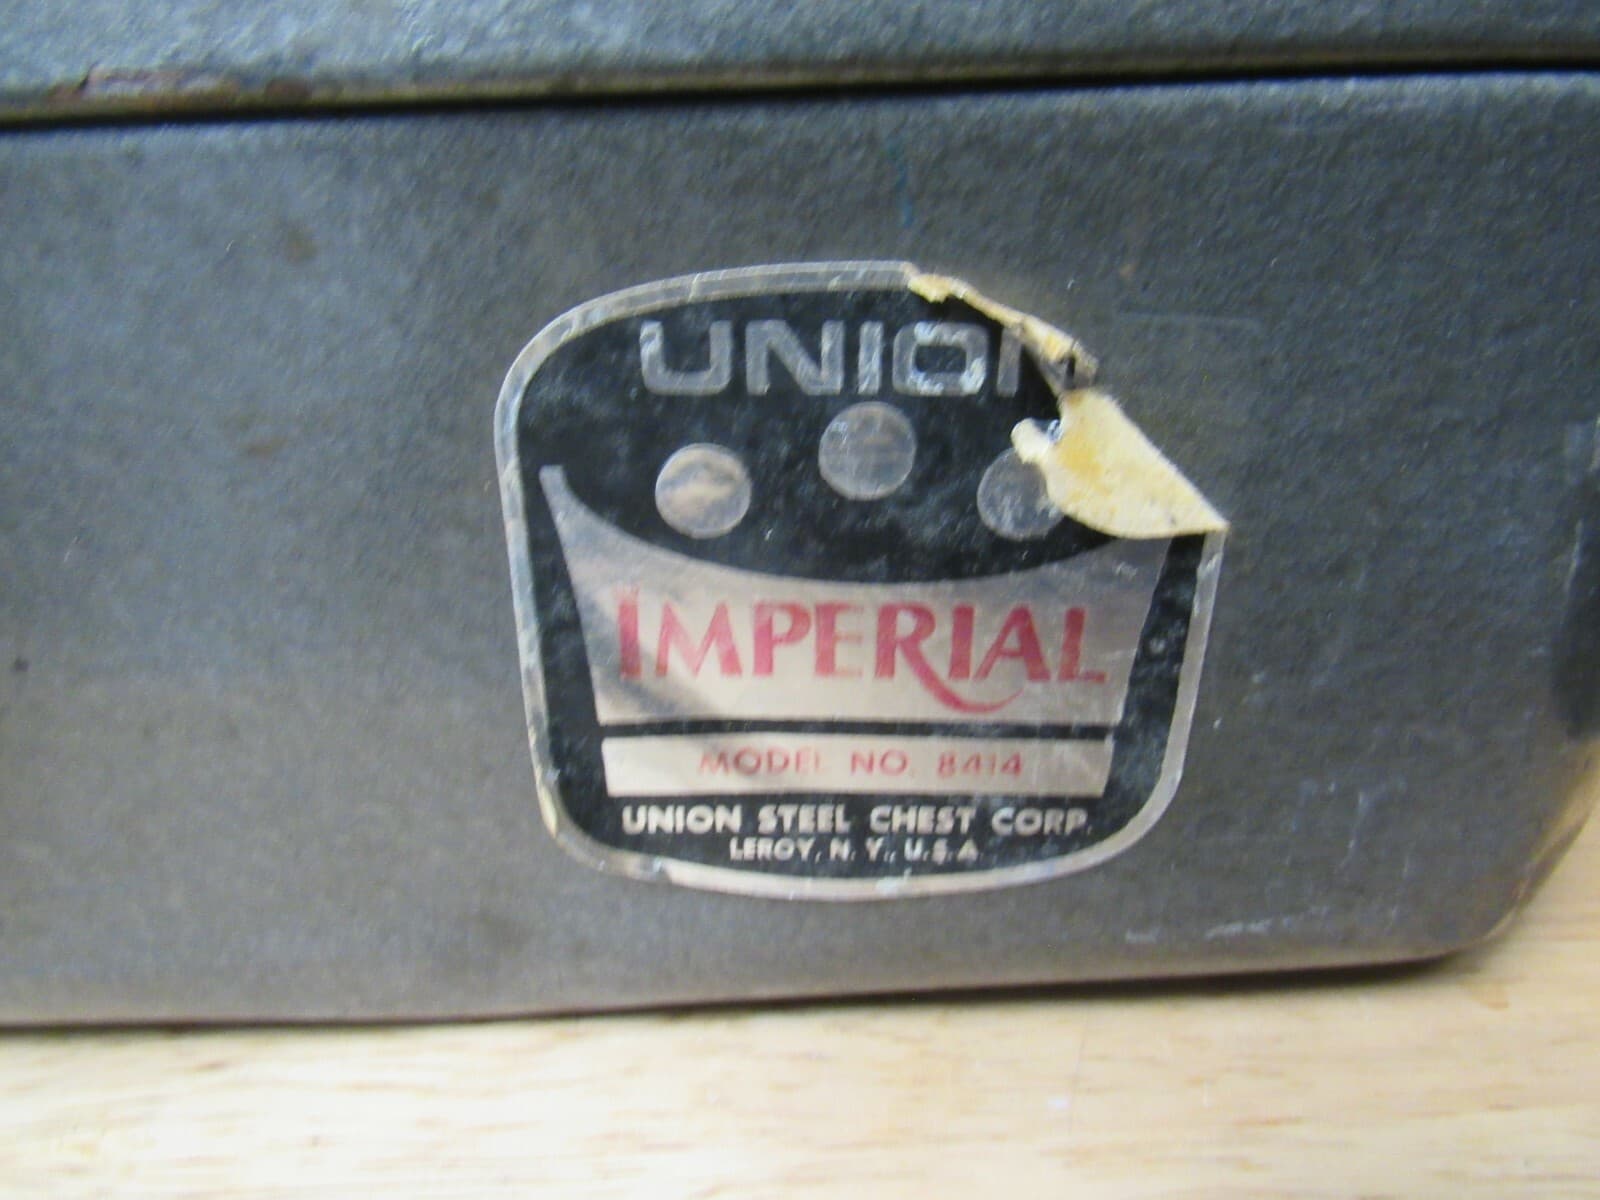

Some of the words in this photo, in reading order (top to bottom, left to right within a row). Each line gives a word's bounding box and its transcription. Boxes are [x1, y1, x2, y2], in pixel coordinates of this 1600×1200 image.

[615, 587, 1106, 714] IMPERIAL
[937, 751, 1022, 777] 8414
[621, 804, 742, 835] UNION
[757, 804, 850, 834] STEEL
[869, 805, 976, 834] CHEST
